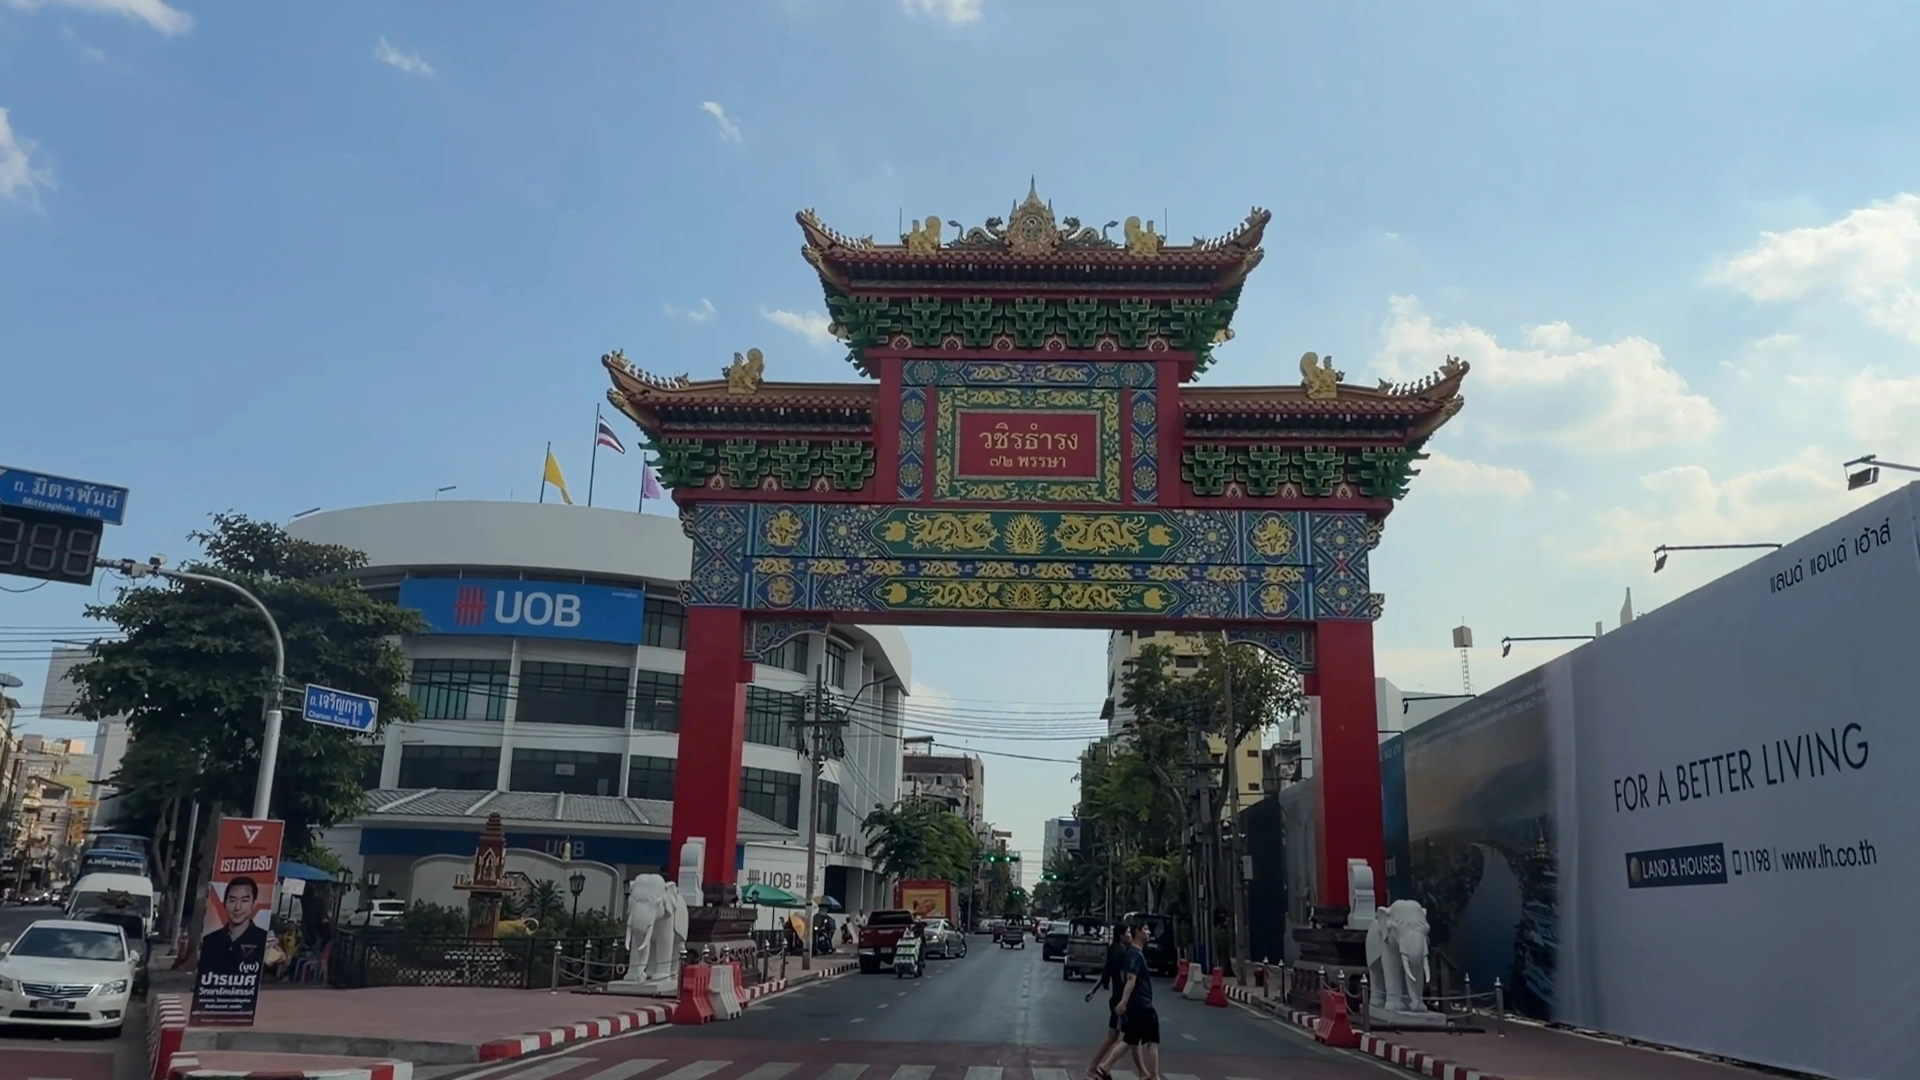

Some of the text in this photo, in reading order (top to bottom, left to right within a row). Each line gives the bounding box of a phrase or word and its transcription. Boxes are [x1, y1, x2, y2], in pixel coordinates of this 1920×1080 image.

[979, 422, 1078, 450] วชิรธำรง
[989, 455, 1066, 468] ๗๒ พรรษา
[22, 496, 76, 513] Mittraphan
[1770, 517, 1892, 594] แลนด์ แอนด์ เฮ้าส์
[494, 590, 581, 628] UOB
[1614, 722, 1869, 813] FOR A BETTER LIVING
[1641, 839, 1877, 879] LAND & HOUSES 1198 www.lh.co.th
[763, 871, 792, 889] UOB
[201, 971, 257, 986] ปารเมศ
